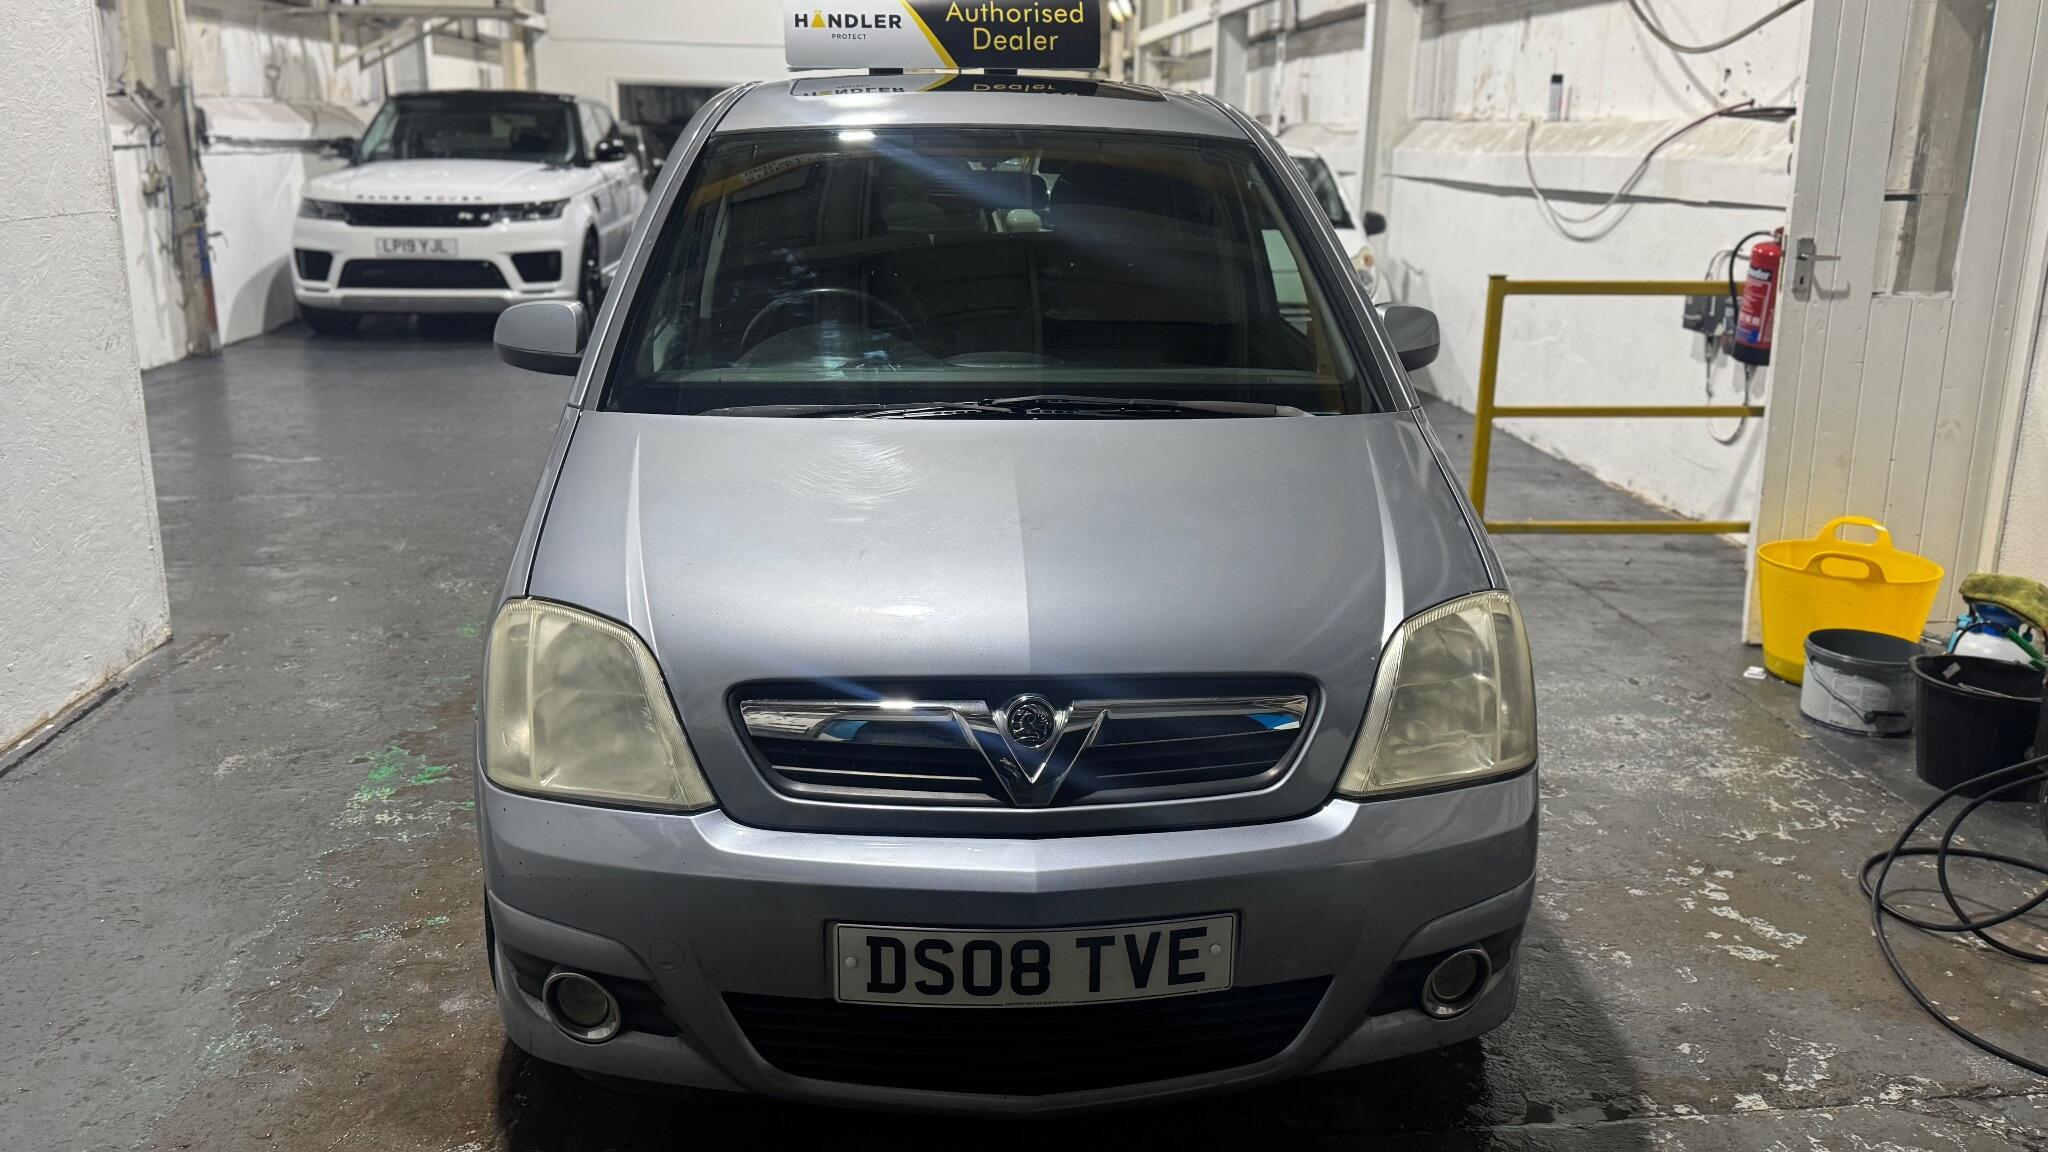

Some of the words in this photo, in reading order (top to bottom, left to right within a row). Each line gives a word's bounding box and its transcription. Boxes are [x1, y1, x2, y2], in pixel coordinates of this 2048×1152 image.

[945, 0, 1084, 23] Authorised
[973, 26, 1059, 51] Dealer
[382, 239, 415, 253] LP19
[418, 239, 448, 253] YJL
[866, 935, 1051, 997] DS08
[1075, 926, 1208, 993] TVE
